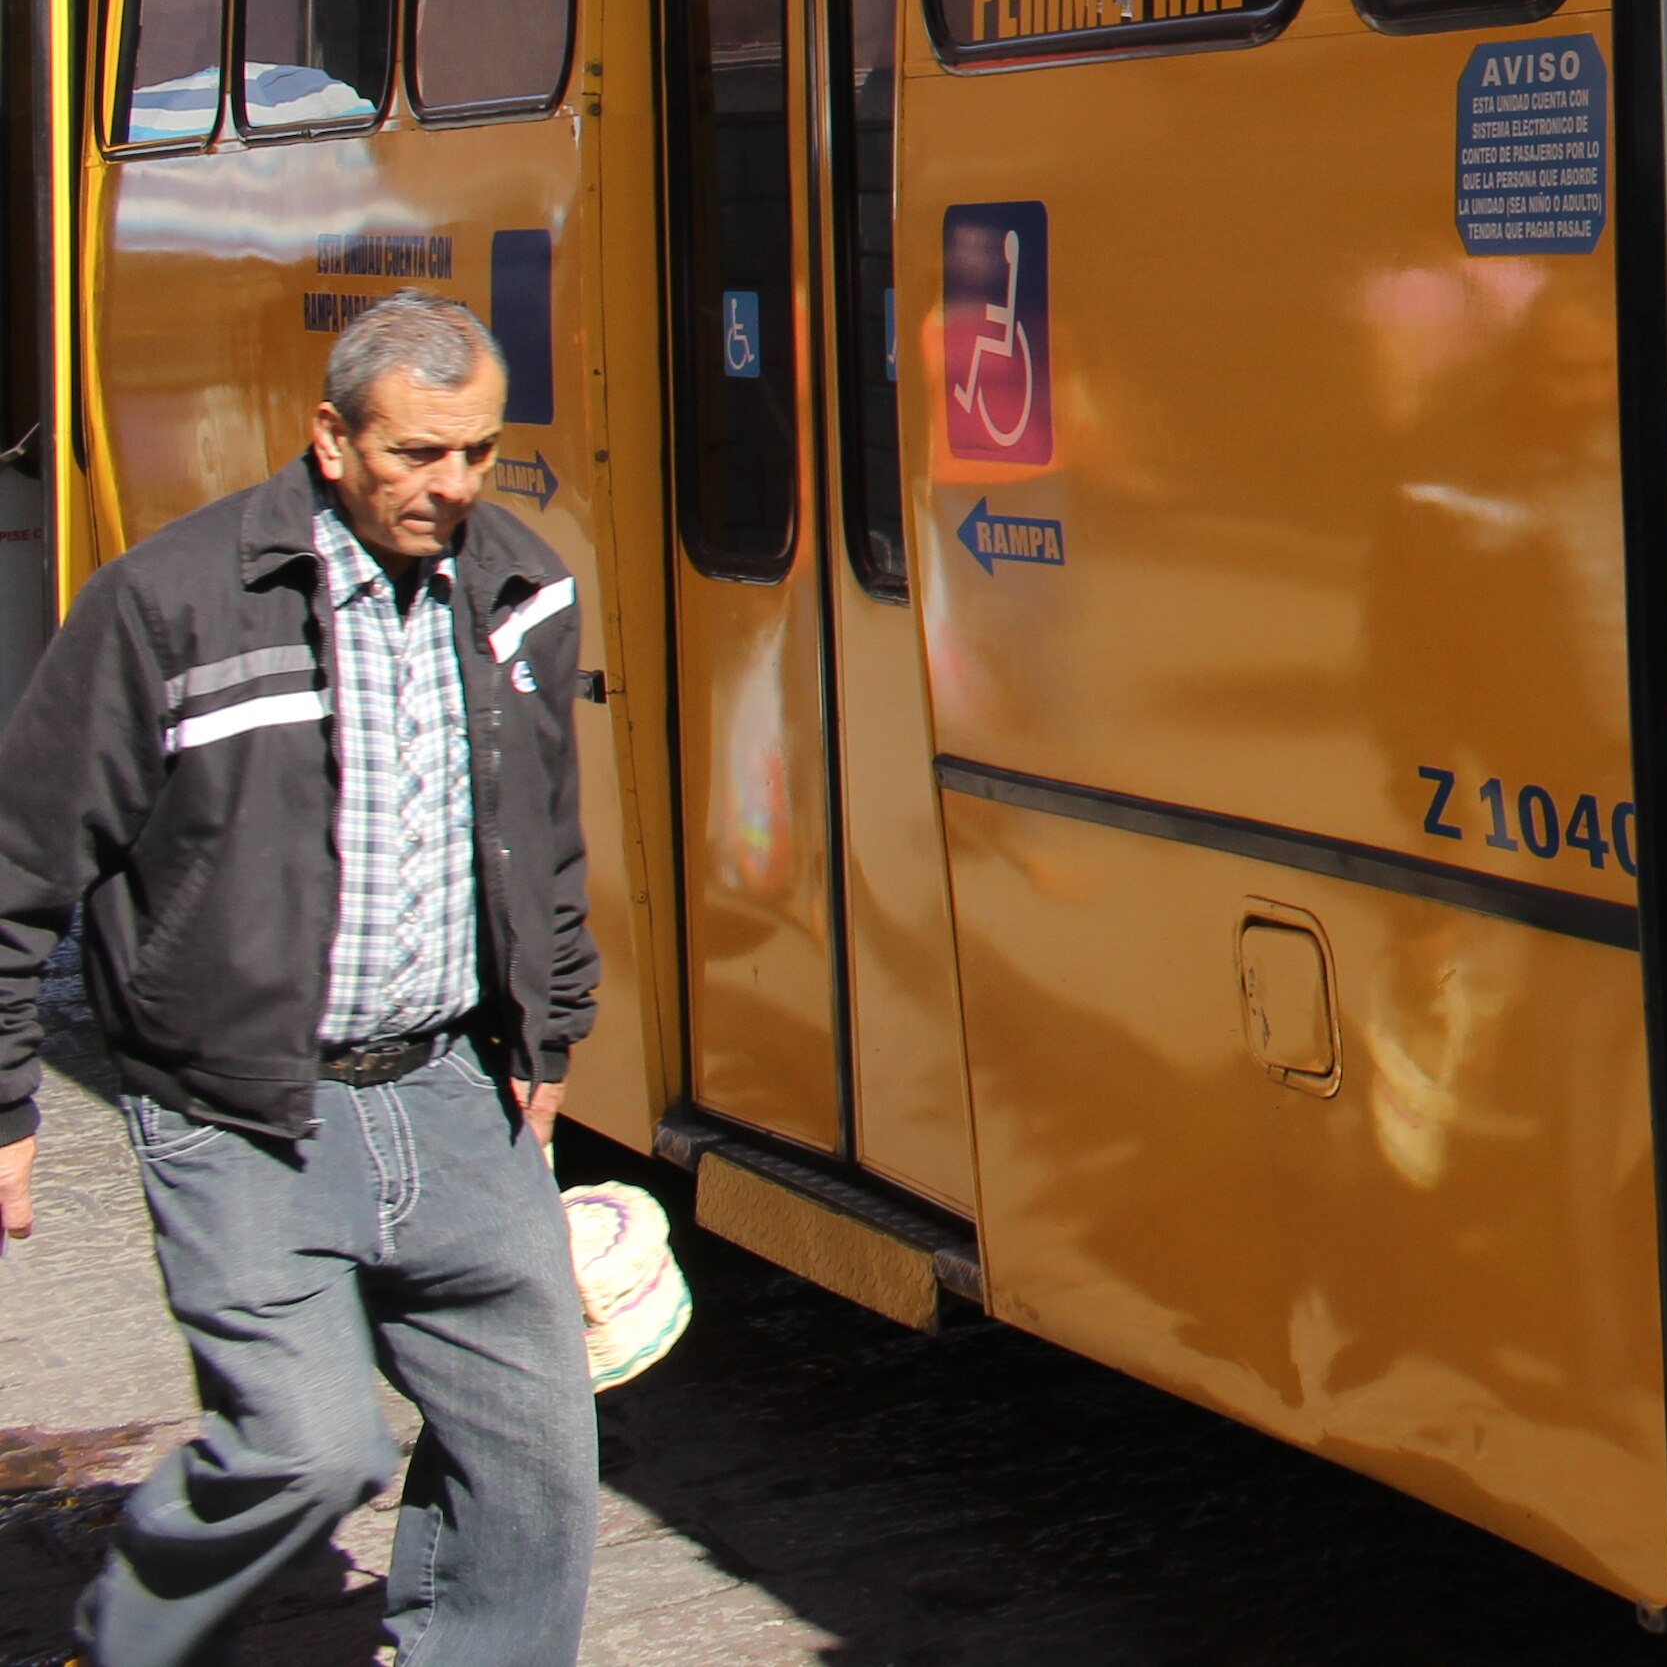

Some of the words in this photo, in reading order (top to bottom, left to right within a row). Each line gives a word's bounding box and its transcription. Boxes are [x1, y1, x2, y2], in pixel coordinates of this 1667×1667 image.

[1482, 50, 1581, 86] AVISO
[1472, 97, 1495, 114] ESTA
[1497, 94, 1530, 112] UNIDAD
[1531, 91, 1568, 111] CUENTA
[1569, 89, 1590, 107] CON
[1472, 120, 1511, 139] SISTEMA
[1576, 116, 1589, 133] DE
[1462, 147, 1497, 165] CONTEO
[1499, 146, 1511, 163] DE
[1512, 143, 1564, 162] PASAJEROS
[1566, 142, 1585, 159] POR
[1587, 141, 1600, 158] LO
[1463, 173, 1481, 190] QUE
[1483, 172, 1495, 189] LA
[1496, 169, 1537, 188] PERSONA
[1539, 169, 1558, 187] QUE
[1560, 167, 1598, 185] ABORDE
[1458, 198, 1469, 215] LA
[1471, 197, 1505, 215] UNIDAD
[1507, 195, 1527, 218] (SEA
[1529, 192, 1551, 214] NIÑO
[1553, 195, 1561, 213] O
[1562, 194, 1602, 216] ADULTO)
[1468, 223, 1503, 240] TENDRA
[1505, 222, 1523, 239] QUE
[1525, 221, 1555, 239] PAGAR
[1557, 220, 1592, 238] PASAJE
[384, 236, 426, 278] CUENTA
[428, 236, 452, 279] CON
[304, 292, 340, 332] RAMPA
[494, 460, 546, 494] RAMPA
[976, 521, 1061, 560] RAMPA
[1417, 765, 1463, 840] Z
